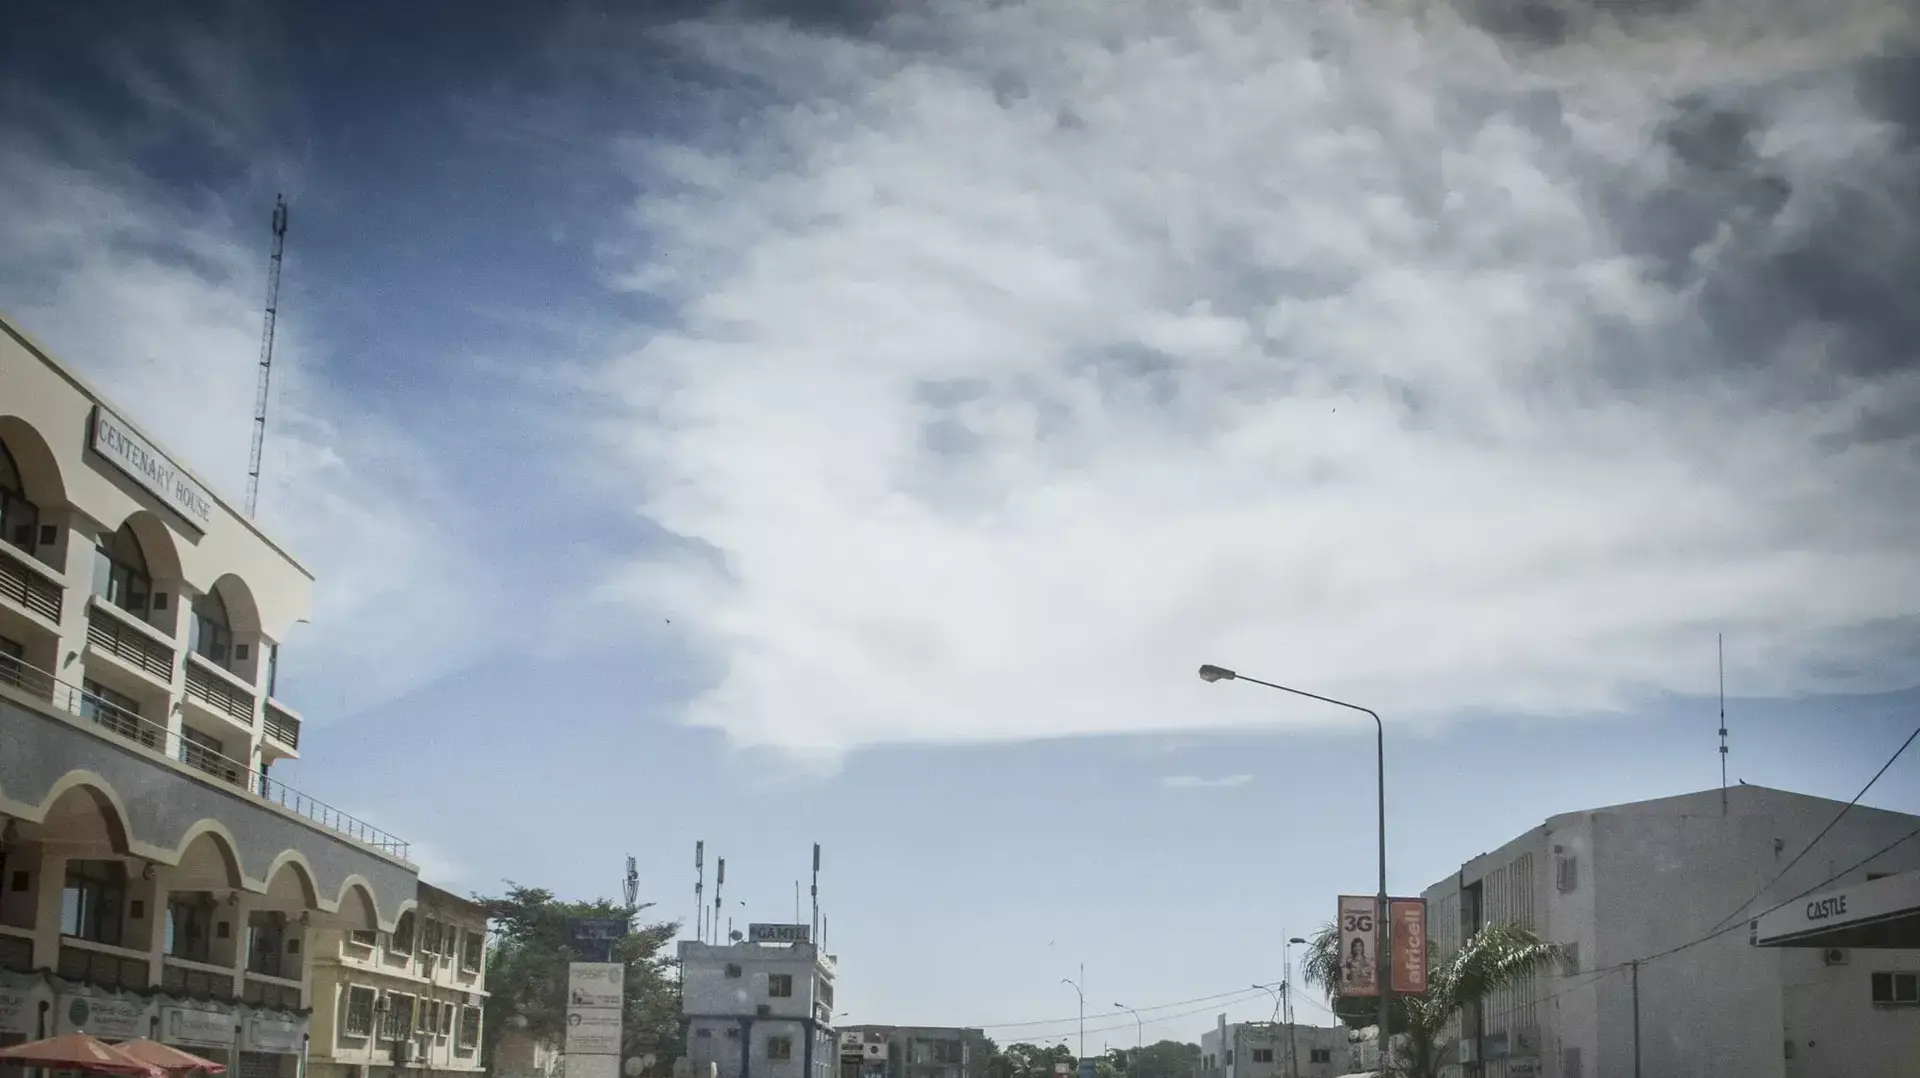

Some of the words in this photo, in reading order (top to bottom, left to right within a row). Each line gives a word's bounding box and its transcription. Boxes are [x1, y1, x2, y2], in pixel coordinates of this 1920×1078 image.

[99, 419, 174, 492] CENTENARY
[175, 479, 211, 523] HOUSE
[1344, 915, 1373, 932] 3G
[1807, 895, 1846, 921] CASTLE
[1404, 910, 1420, 983] africell
